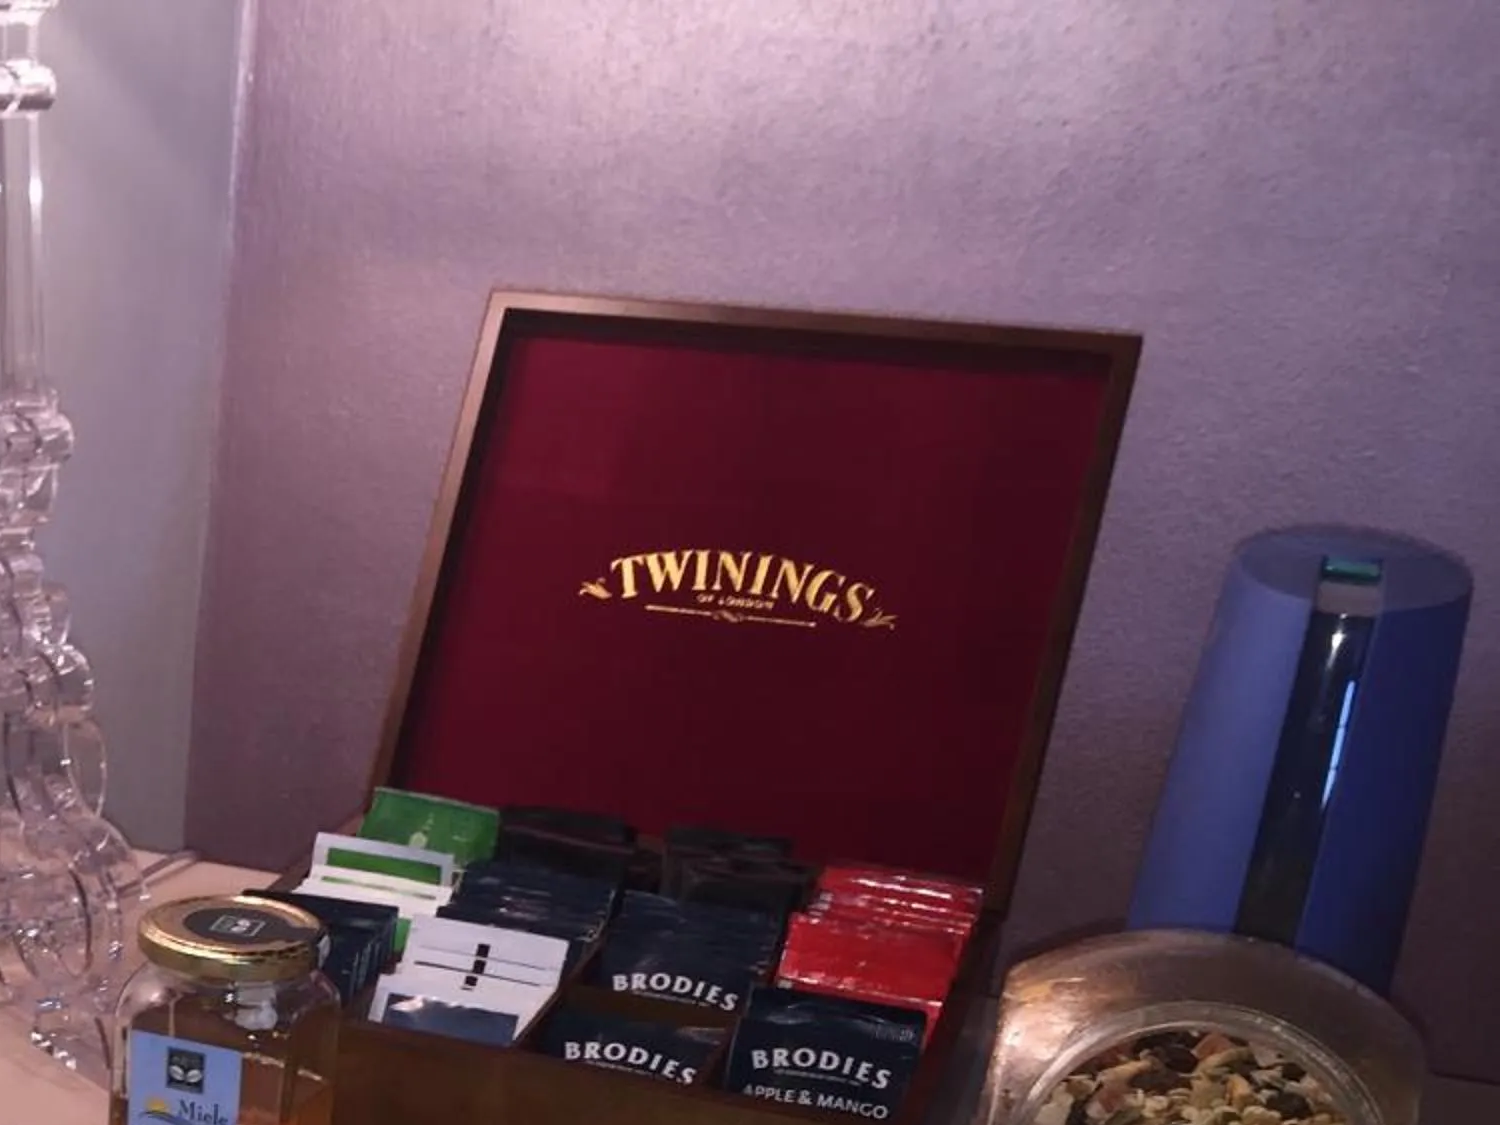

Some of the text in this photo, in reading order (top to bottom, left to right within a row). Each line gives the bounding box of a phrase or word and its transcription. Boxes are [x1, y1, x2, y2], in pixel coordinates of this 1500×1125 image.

[610, 550, 875, 623] TWININGS
[612, 973, 739, 1011] BRODIES
[564, 1041, 697, 1085] BRODIES
[751, 1048, 892, 1089] BRODIES
[742, 1083, 889, 1120] APPLE & MANGO
